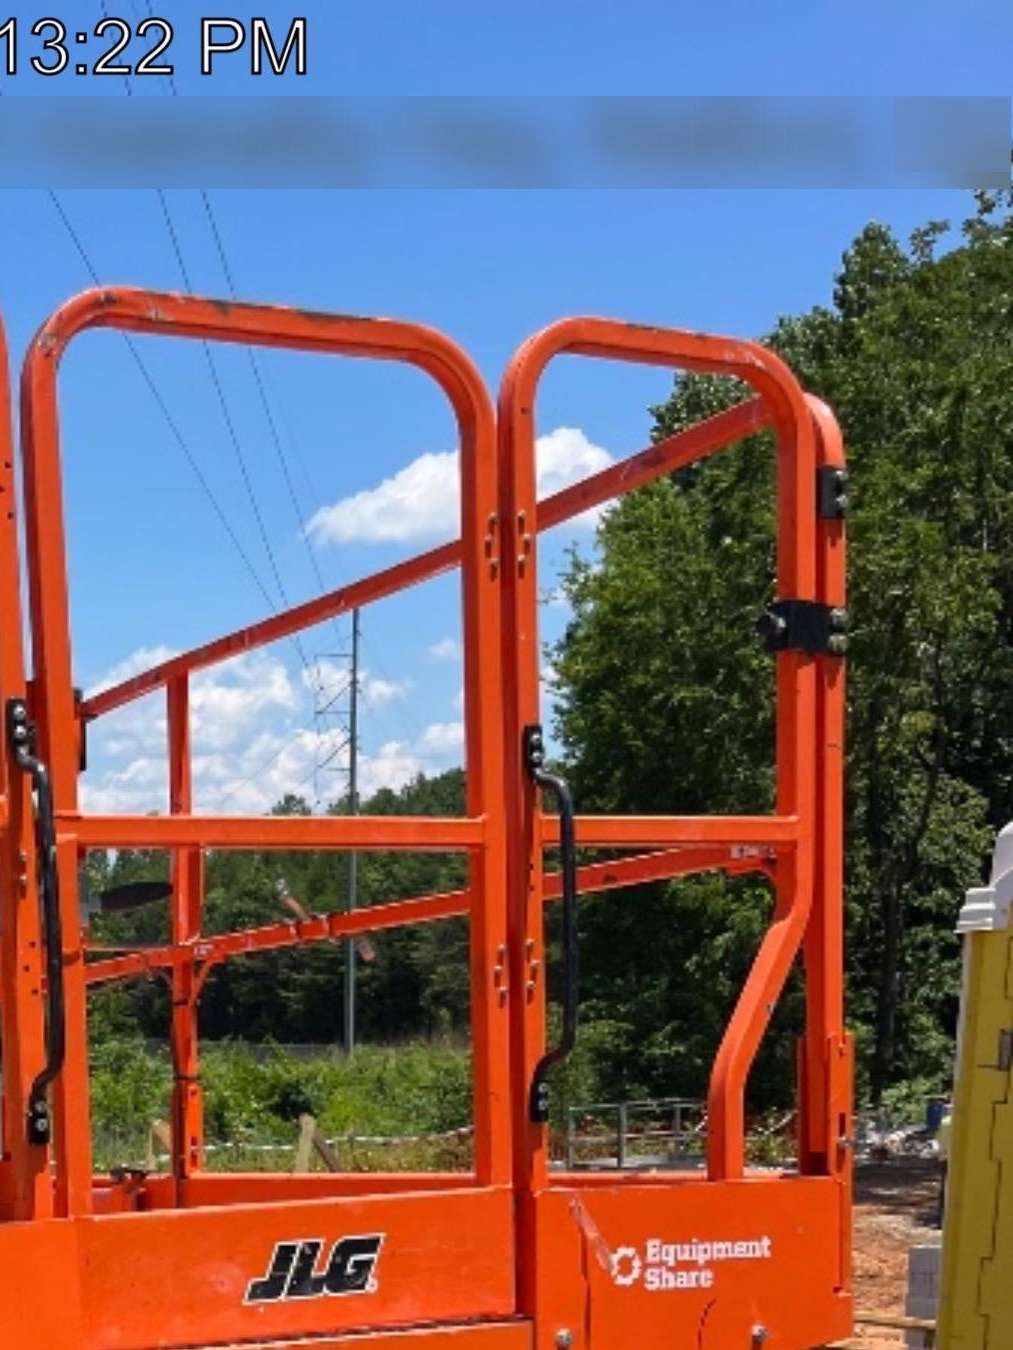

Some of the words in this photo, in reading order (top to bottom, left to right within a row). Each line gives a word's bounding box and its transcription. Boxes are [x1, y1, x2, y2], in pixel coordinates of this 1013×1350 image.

[645, 1235, 772, 1267] Equipment
[242, 1232, 386, 1306] JLG
[644, 1266, 714, 1291] Share
